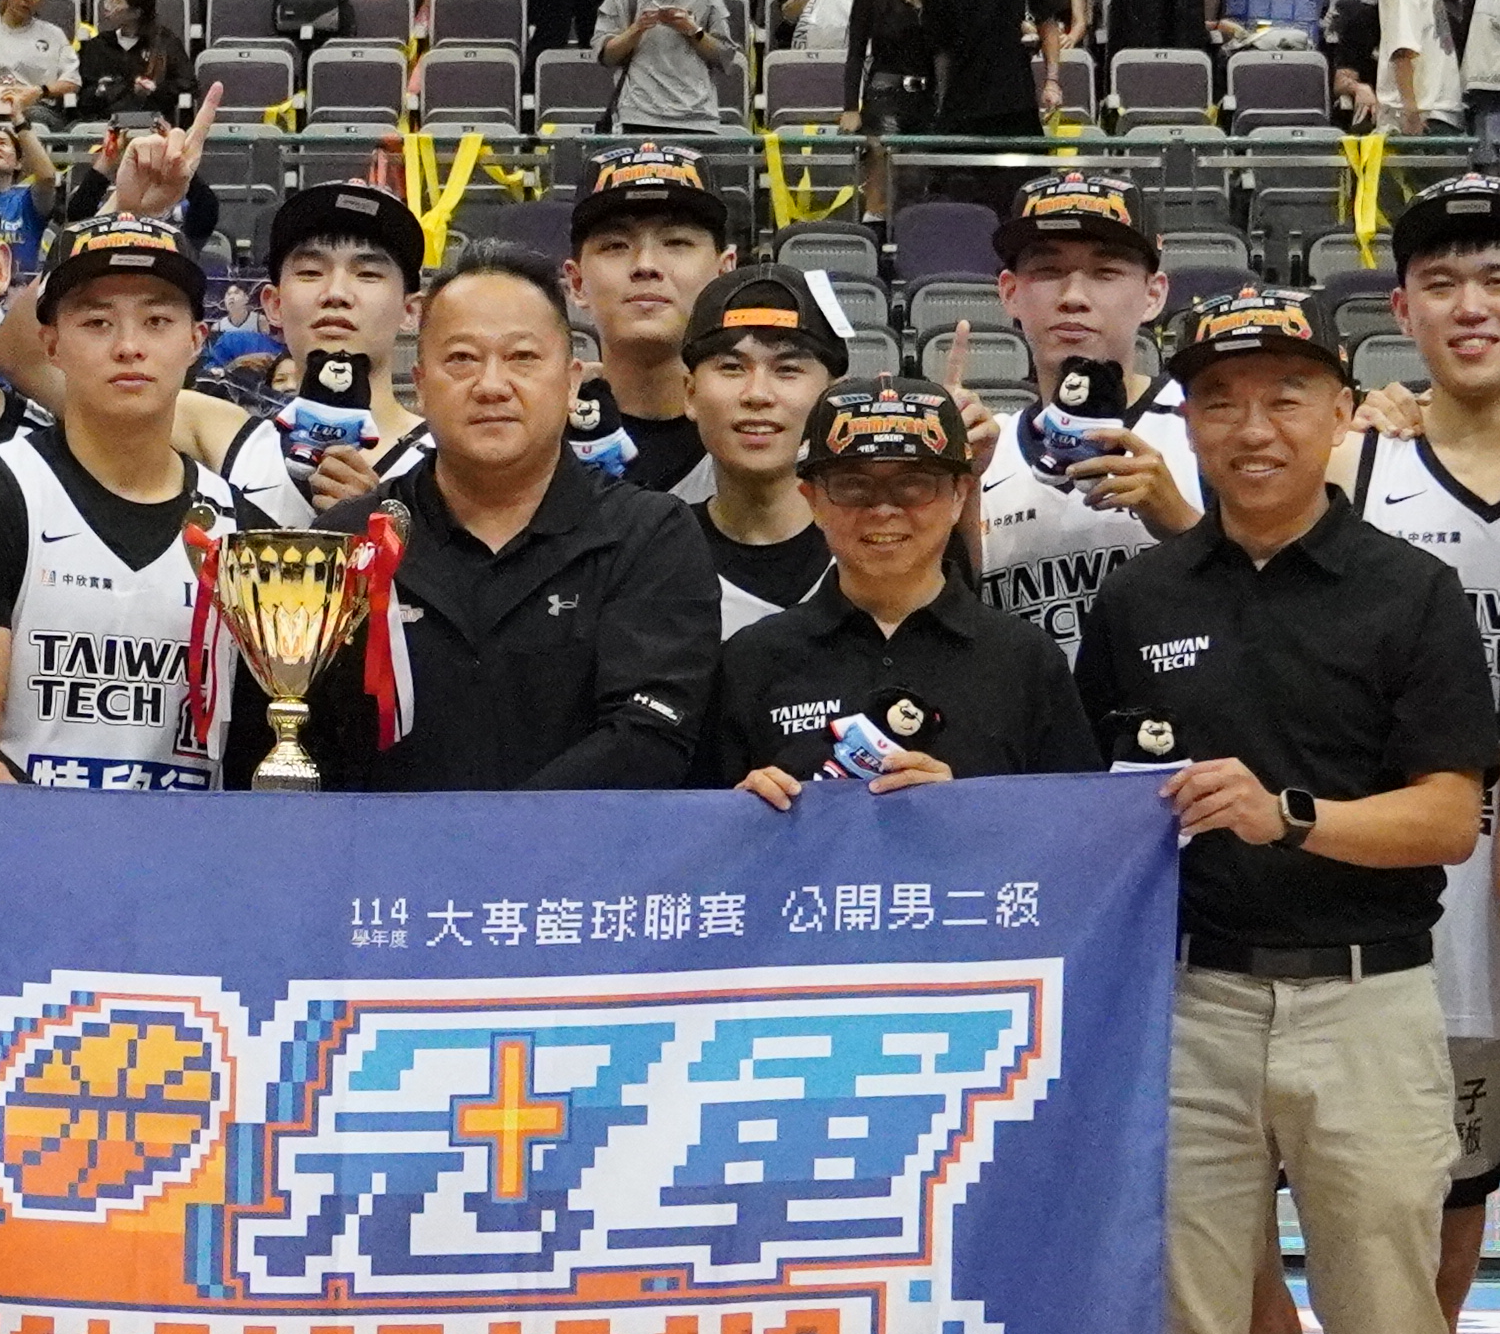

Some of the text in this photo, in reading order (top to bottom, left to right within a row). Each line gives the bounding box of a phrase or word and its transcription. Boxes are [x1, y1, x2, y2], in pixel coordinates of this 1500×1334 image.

[825, 409, 950, 455] CHAMPIONS
[1139, 635, 1210, 661] TAIWAN
[1151, 651, 1196, 673] TECH
[31, 678, 166, 727] TECH
[769, 698, 841, 724] TAIWAN
[779, 715, 827, 736] TECH
[350, 881, 1041, 947] 114 大專籃球聯賽 公開男二級
[350, 927, 409, 950] 學年度
[252, 1009, 1016, 1277] 冠軍
